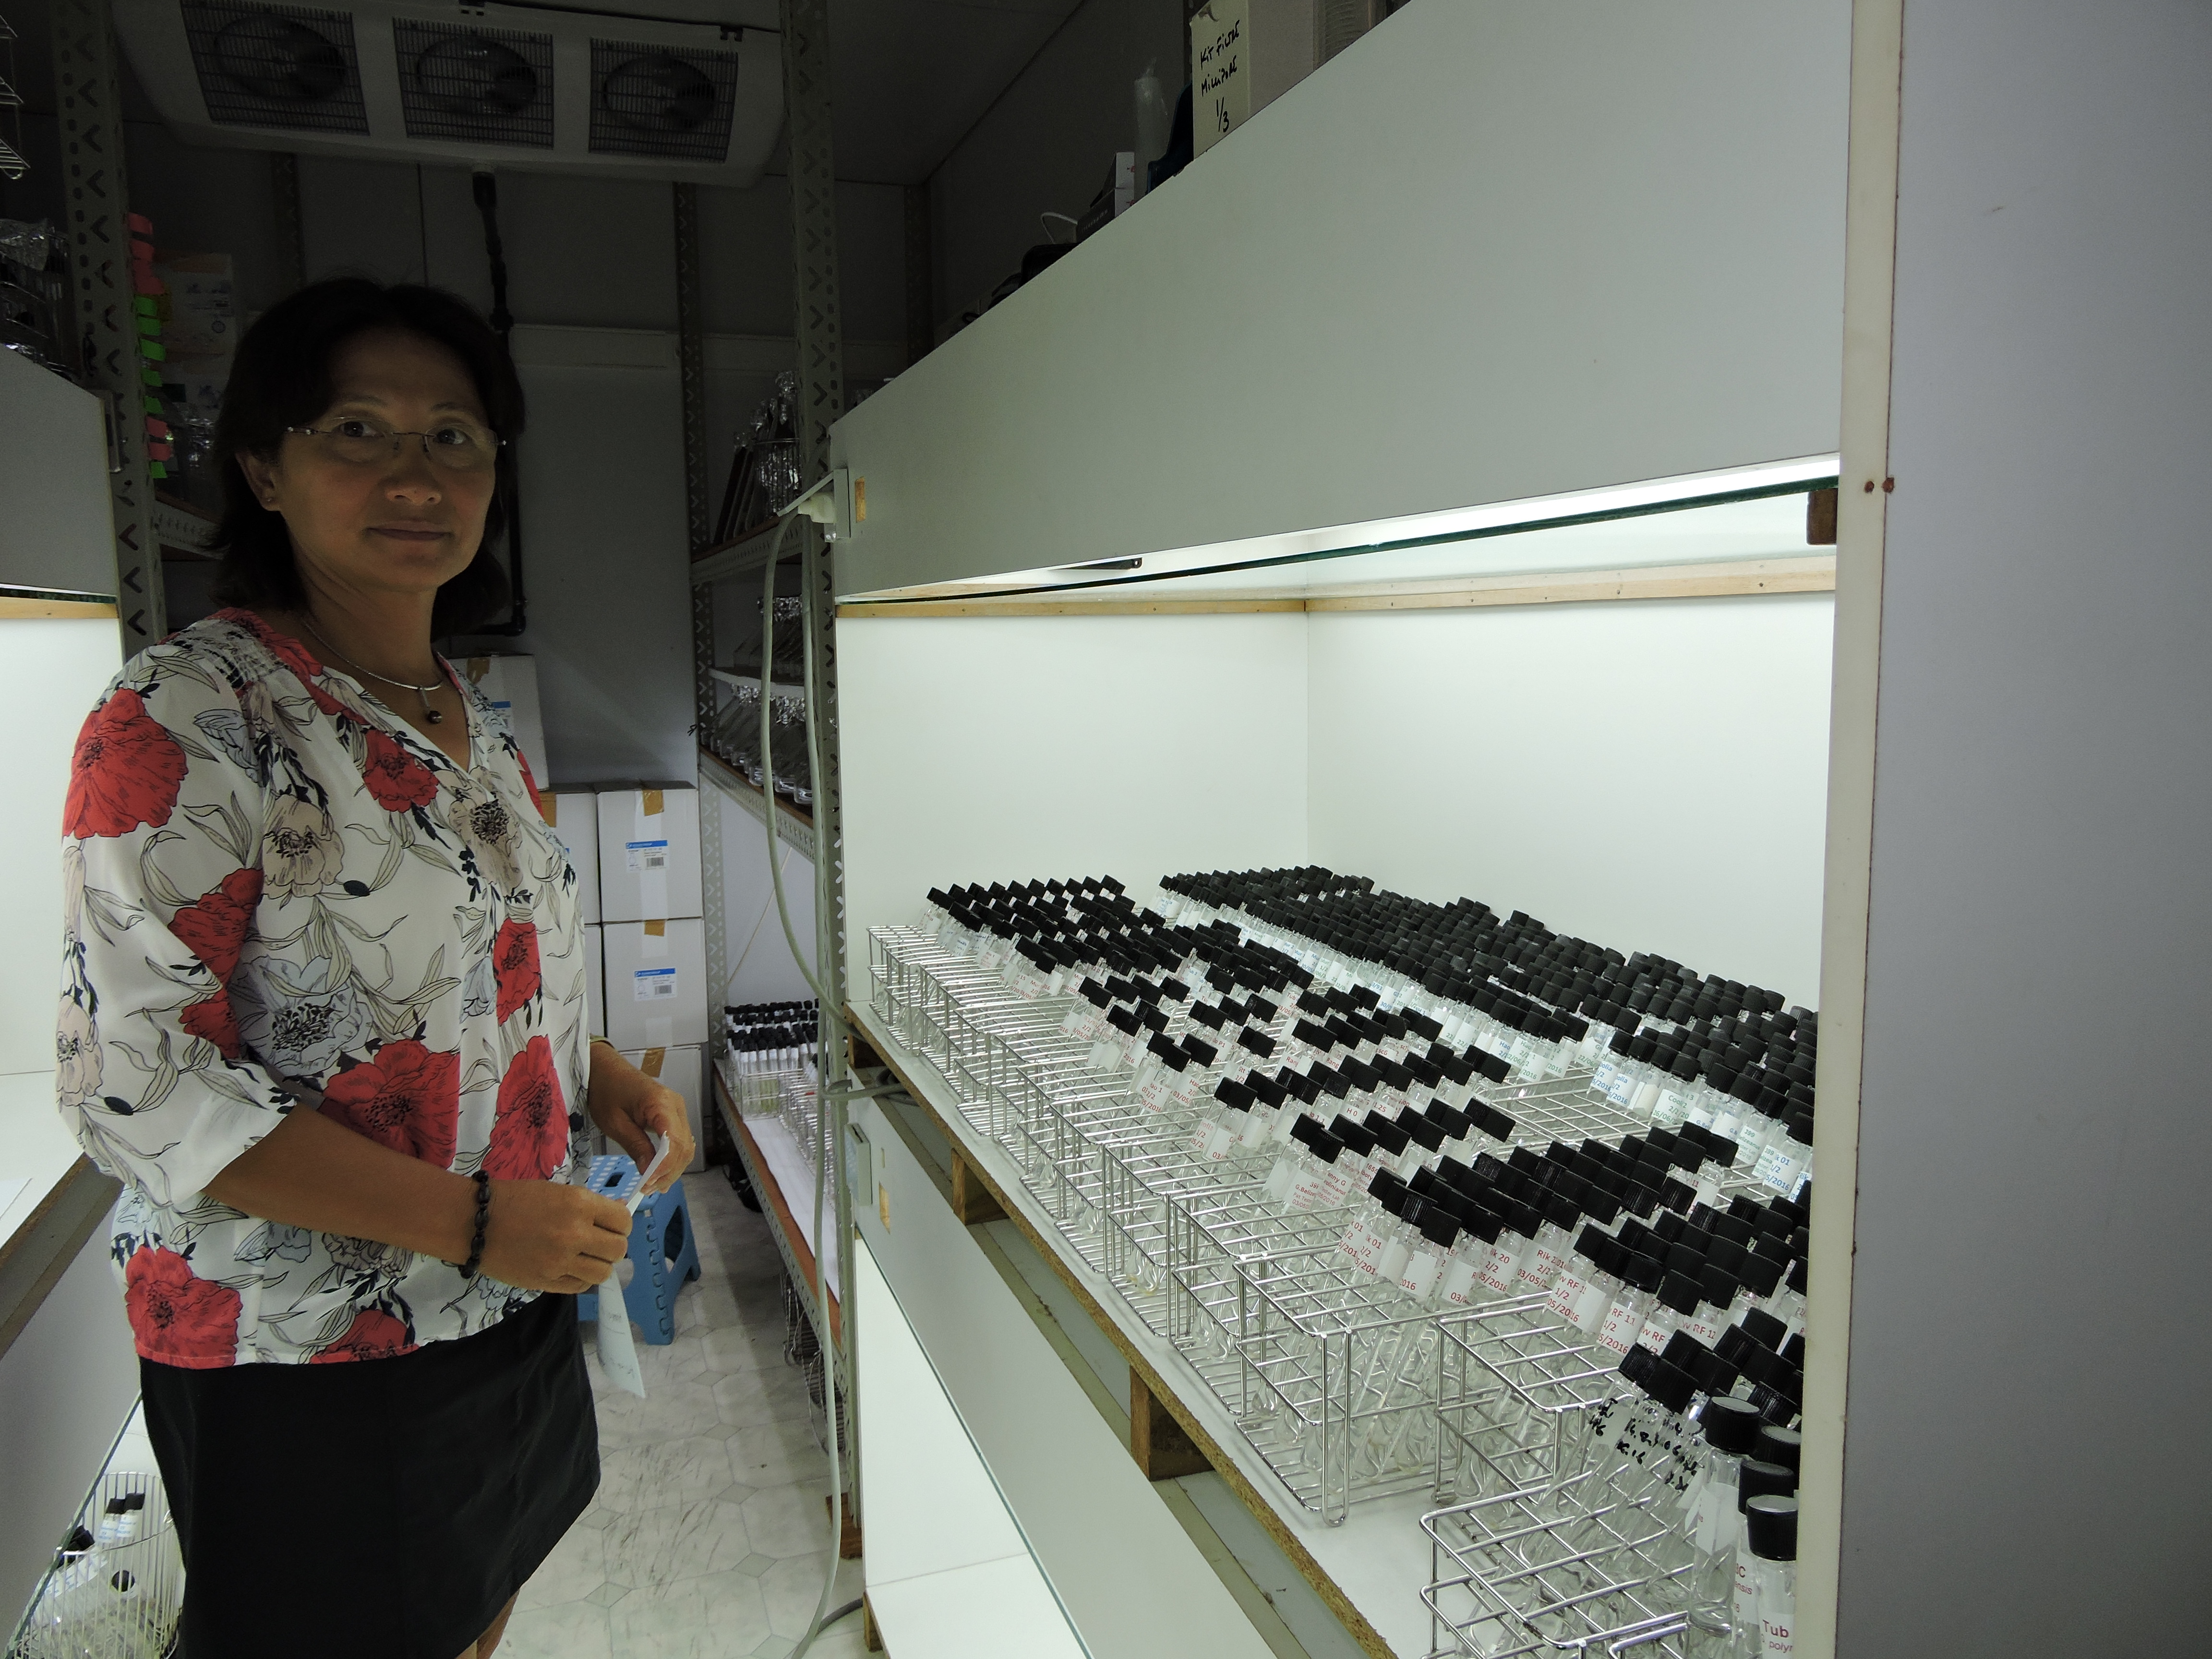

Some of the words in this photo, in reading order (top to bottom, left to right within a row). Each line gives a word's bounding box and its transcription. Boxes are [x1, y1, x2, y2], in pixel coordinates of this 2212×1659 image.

[1216, 96, 1229, 132] 1/3
[1354, 1222, 1364, 1233] 01
[1371, 1238, 1382, 1250] 01
[1498, 1253, 1510, 1264] 20
[1537, 1249, 1551, 1261] Rik
[1567, 1278, 1580, 1289] RF
[1555, 1287, 1570, 1300] 1/2
[1611, 1308, 1623, 1318] RF
[1693, 1323, 1707, 1334] RF
[1651, 1331, 1666, 1343] RF
[1762, 1619, 1789, 1638] Tub
